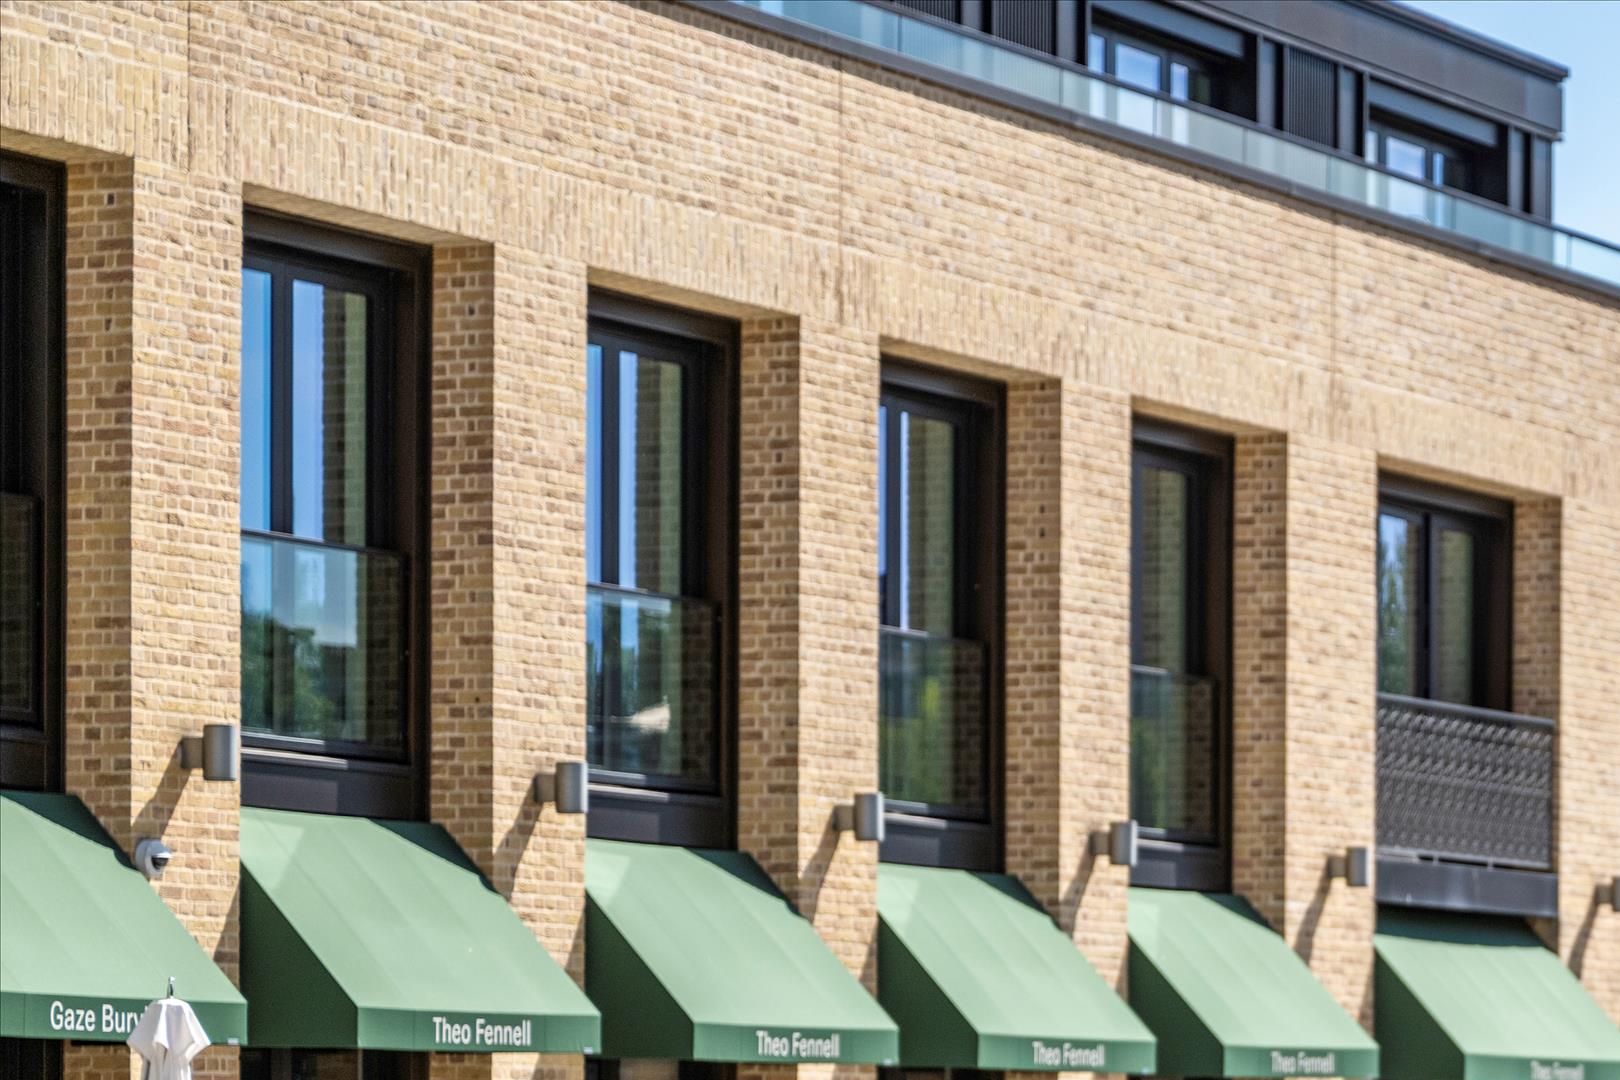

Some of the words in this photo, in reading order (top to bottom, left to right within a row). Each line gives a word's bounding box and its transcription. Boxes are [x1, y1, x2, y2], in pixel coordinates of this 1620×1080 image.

[50, 1000, 96, 1032] Gaze
[432, 1016, 471, 1045] Theo
[475, 1018, 531, 1046] Fennell
[756, 1030, 789, 1057] Theo
[791, 1032, 839, 1058] Fennell
[1032, 1040, 1061, 1066] Theo
[1062, 1042, 1105, 1068] Fennell
